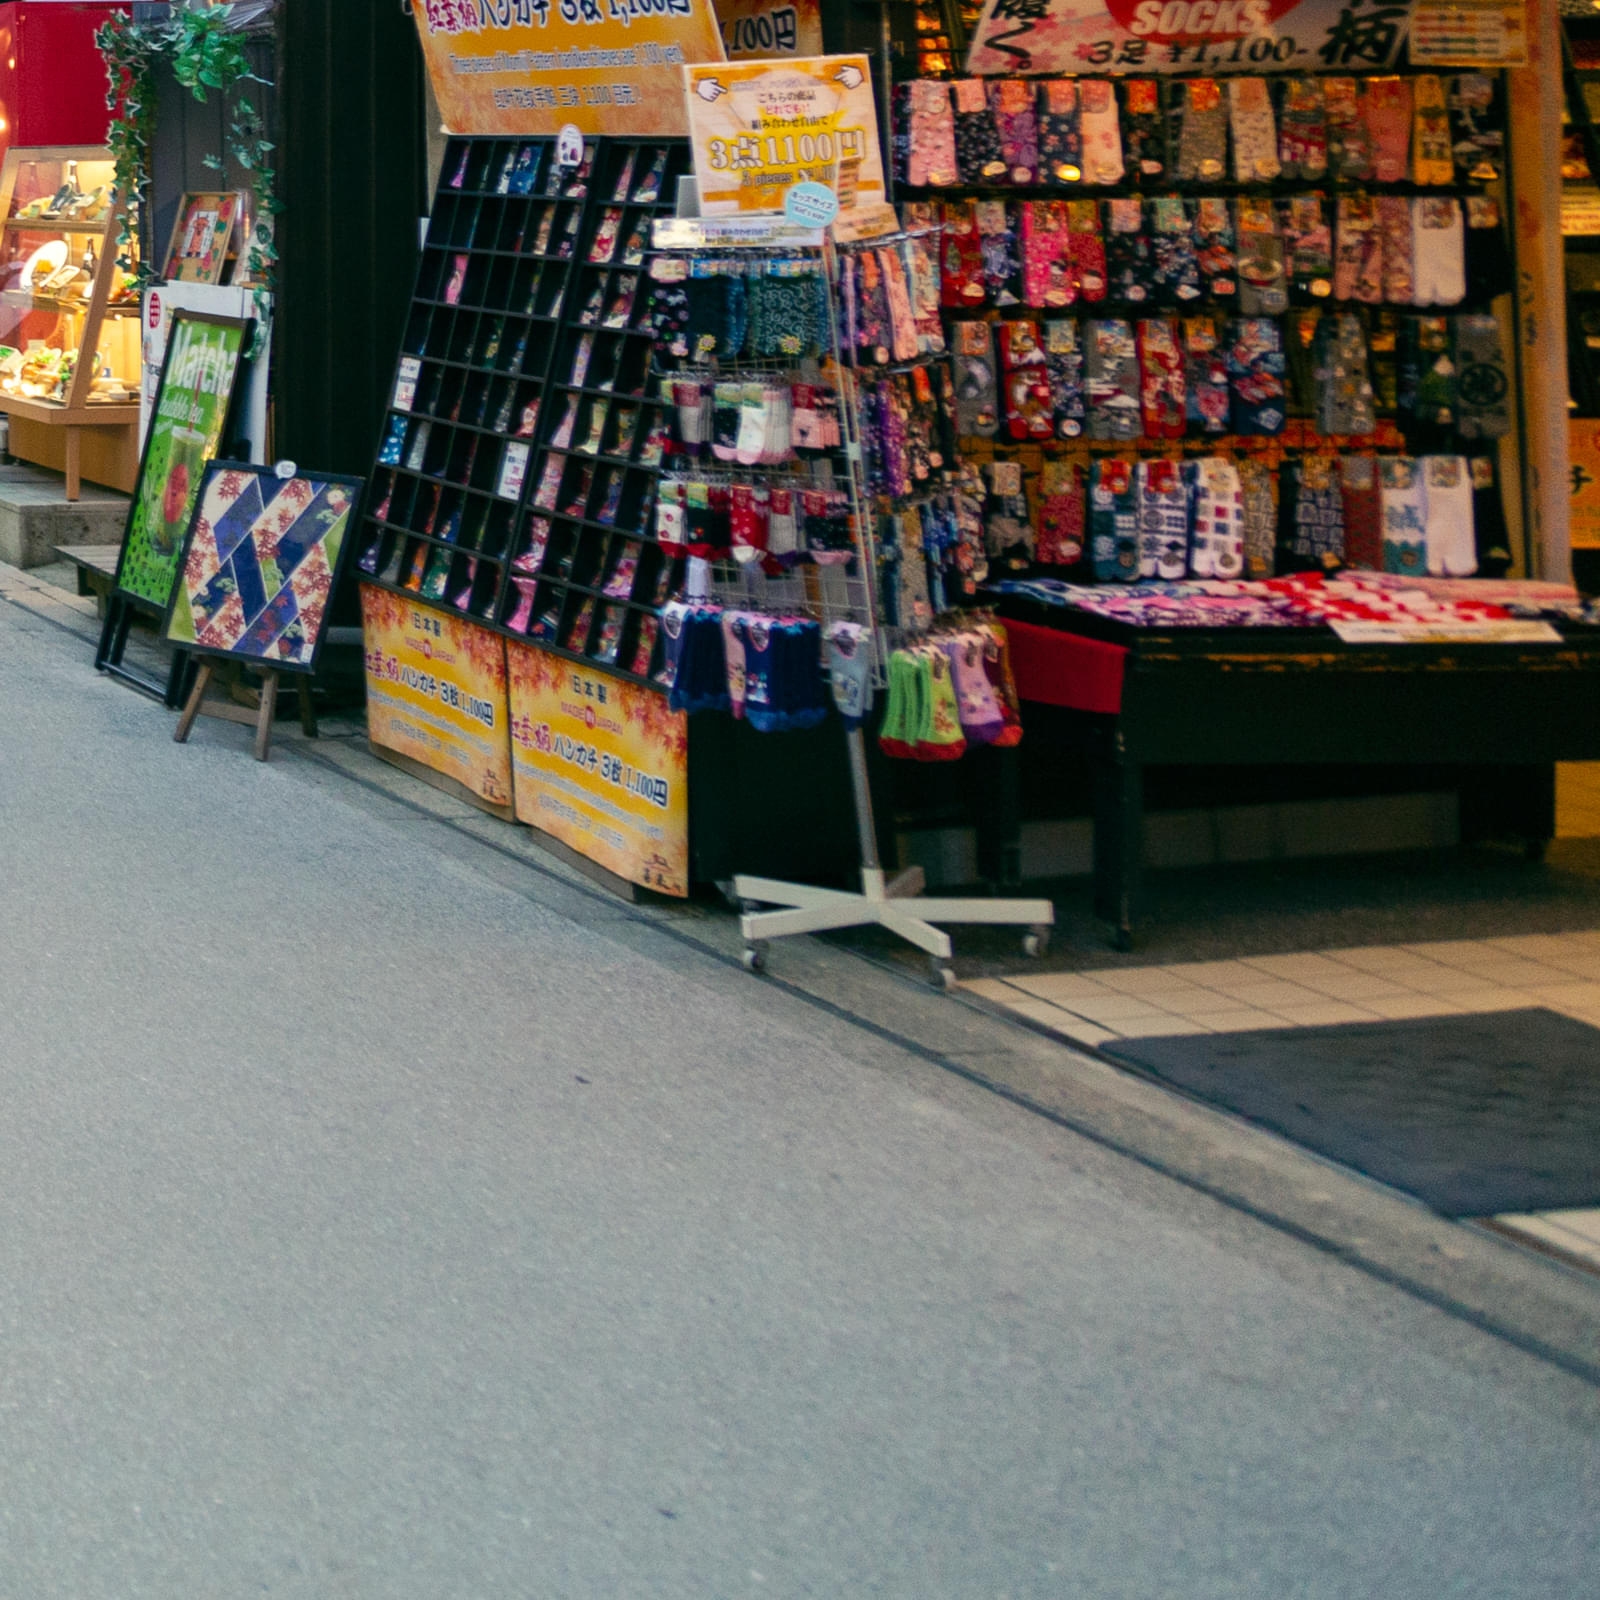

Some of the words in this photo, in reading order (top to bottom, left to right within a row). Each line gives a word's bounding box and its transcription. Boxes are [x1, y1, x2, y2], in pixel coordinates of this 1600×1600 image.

[1130, 0, 1271, 36] SOCKS
[165, 322, 238, 396] Matcha
[413, 612, 442, 637] 日本製
[440, 682, 460, 707] 3枚
[572, 675, 608, 704] 日本製
[601, 754, 623, 783] 3枚
[625, 766, 669, 808] 1,100円
